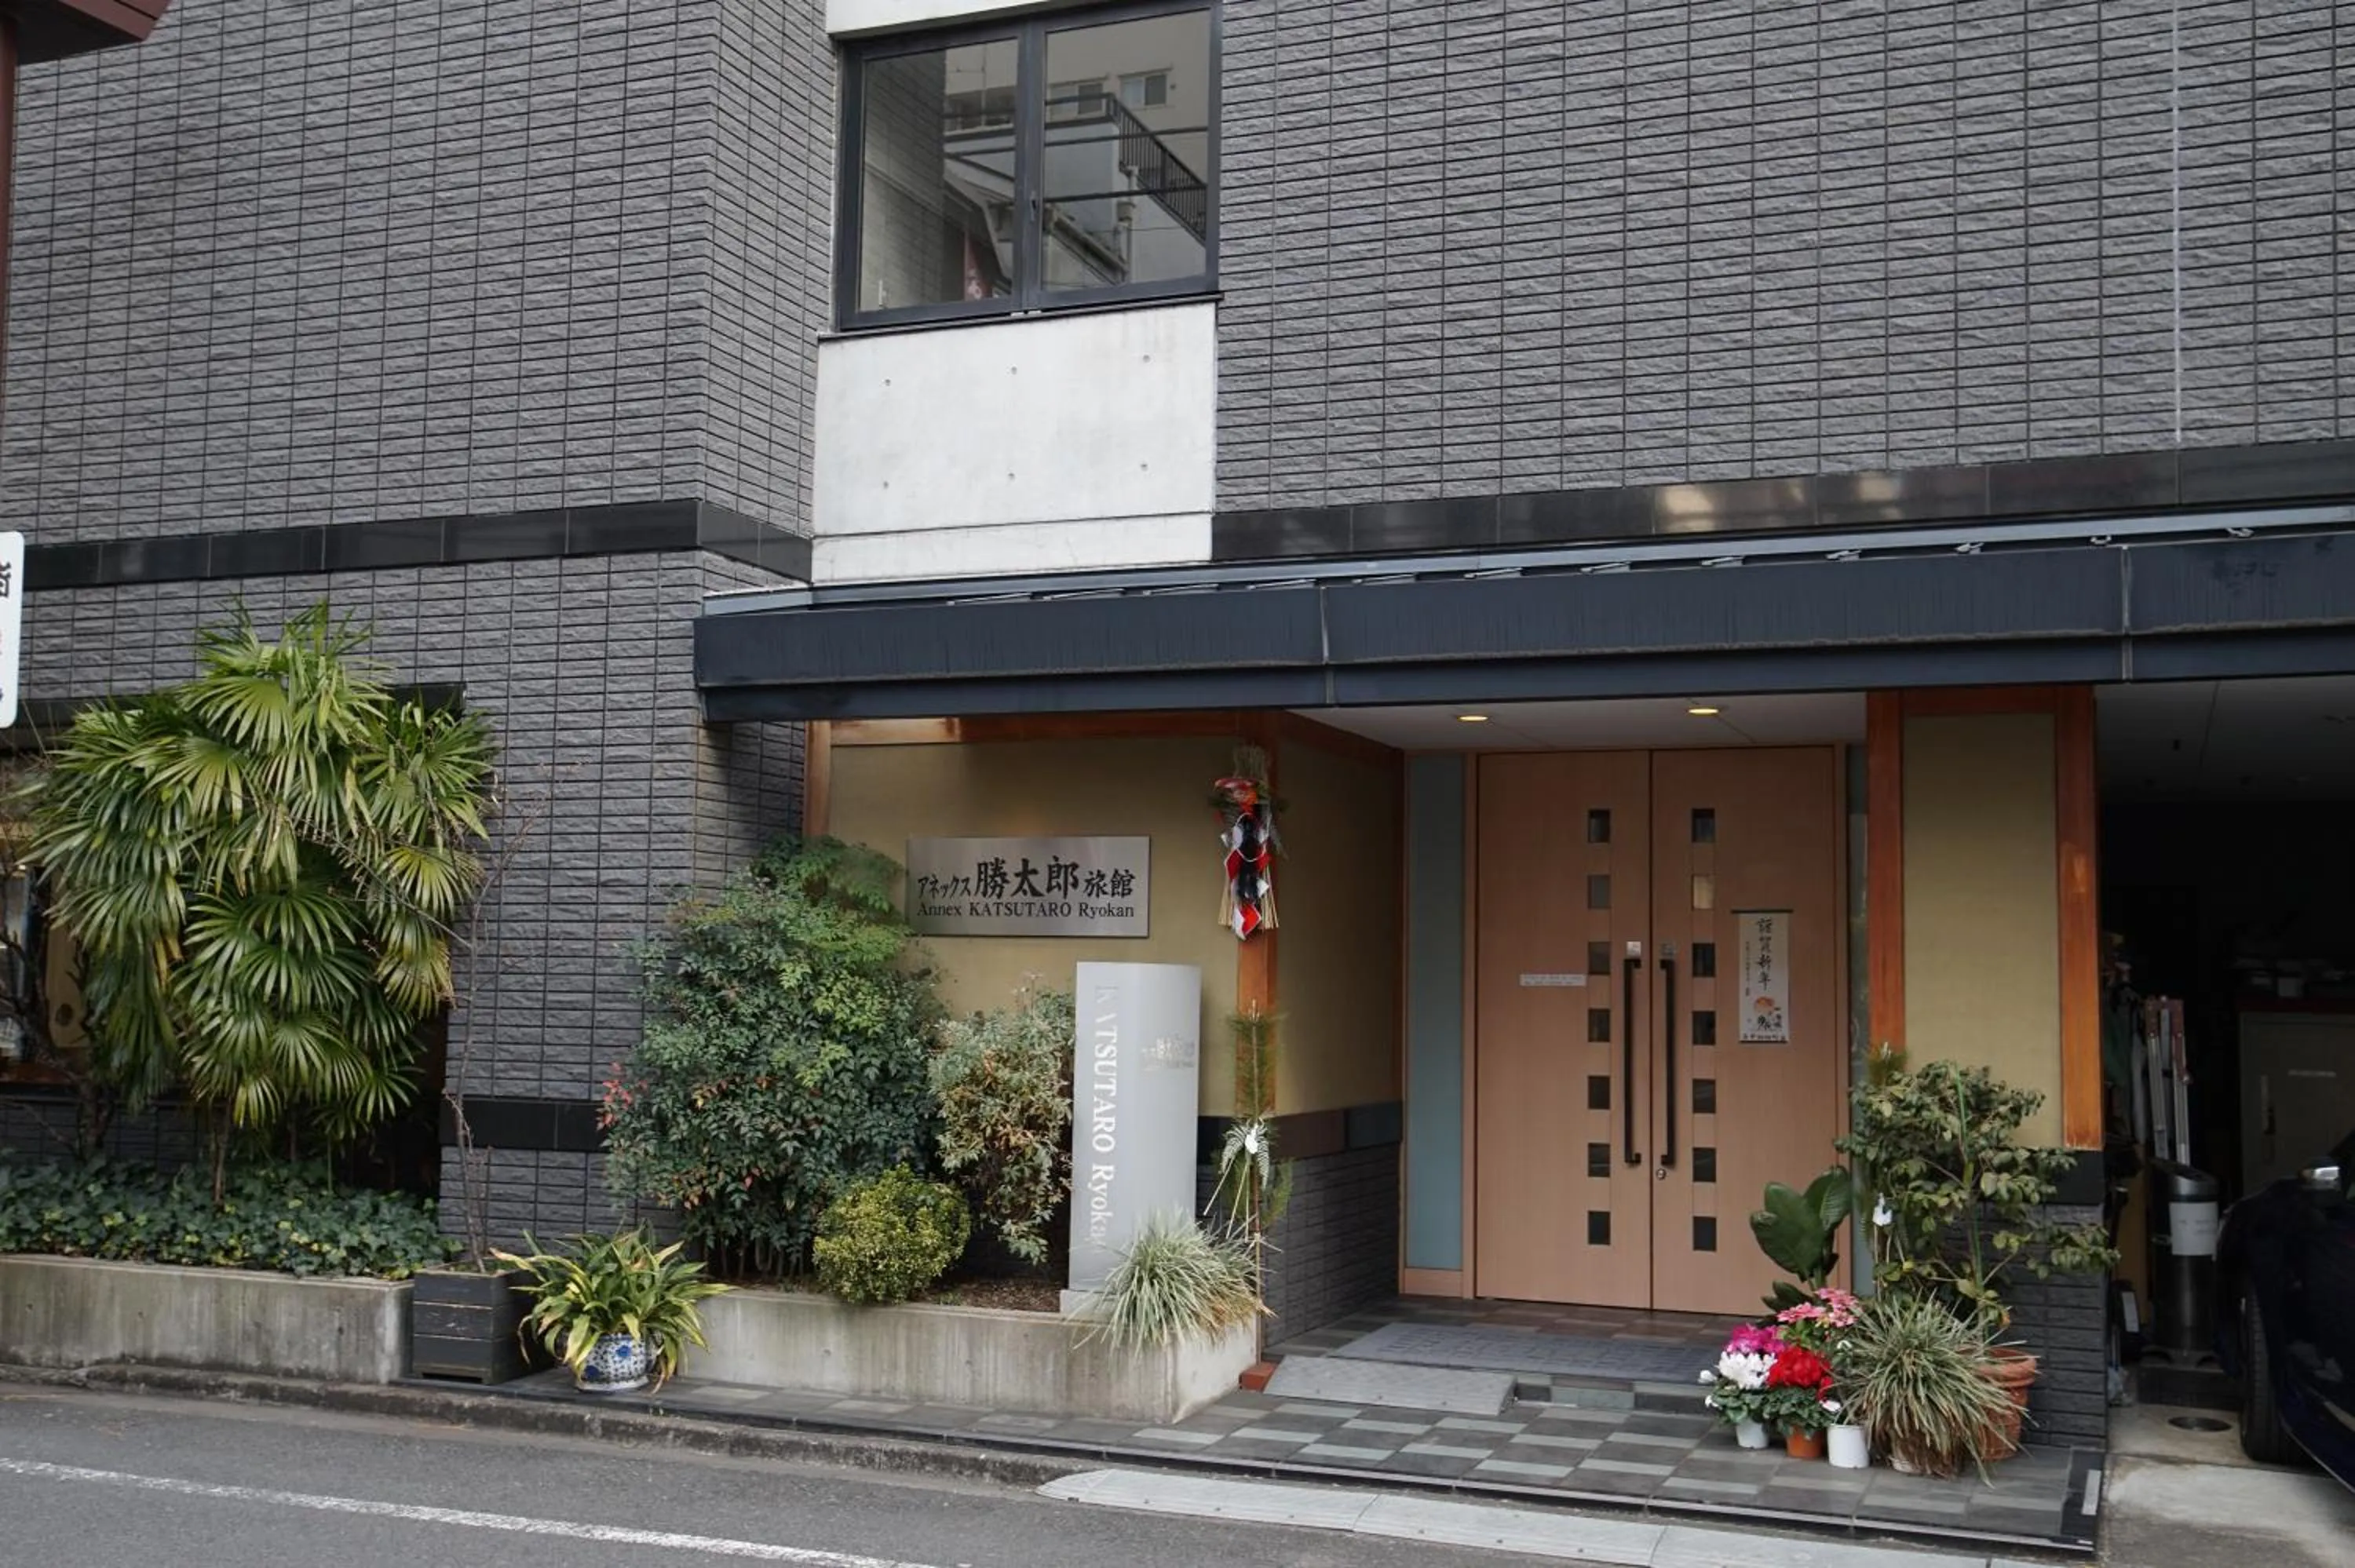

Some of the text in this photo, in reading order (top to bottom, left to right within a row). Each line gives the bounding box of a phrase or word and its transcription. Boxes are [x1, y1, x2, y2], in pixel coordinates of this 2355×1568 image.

[917, 855, 1135, 899] アネックス勝太郎旅館
[917, 901, 1134, 919] Annex KATSUTARO Ryokan
